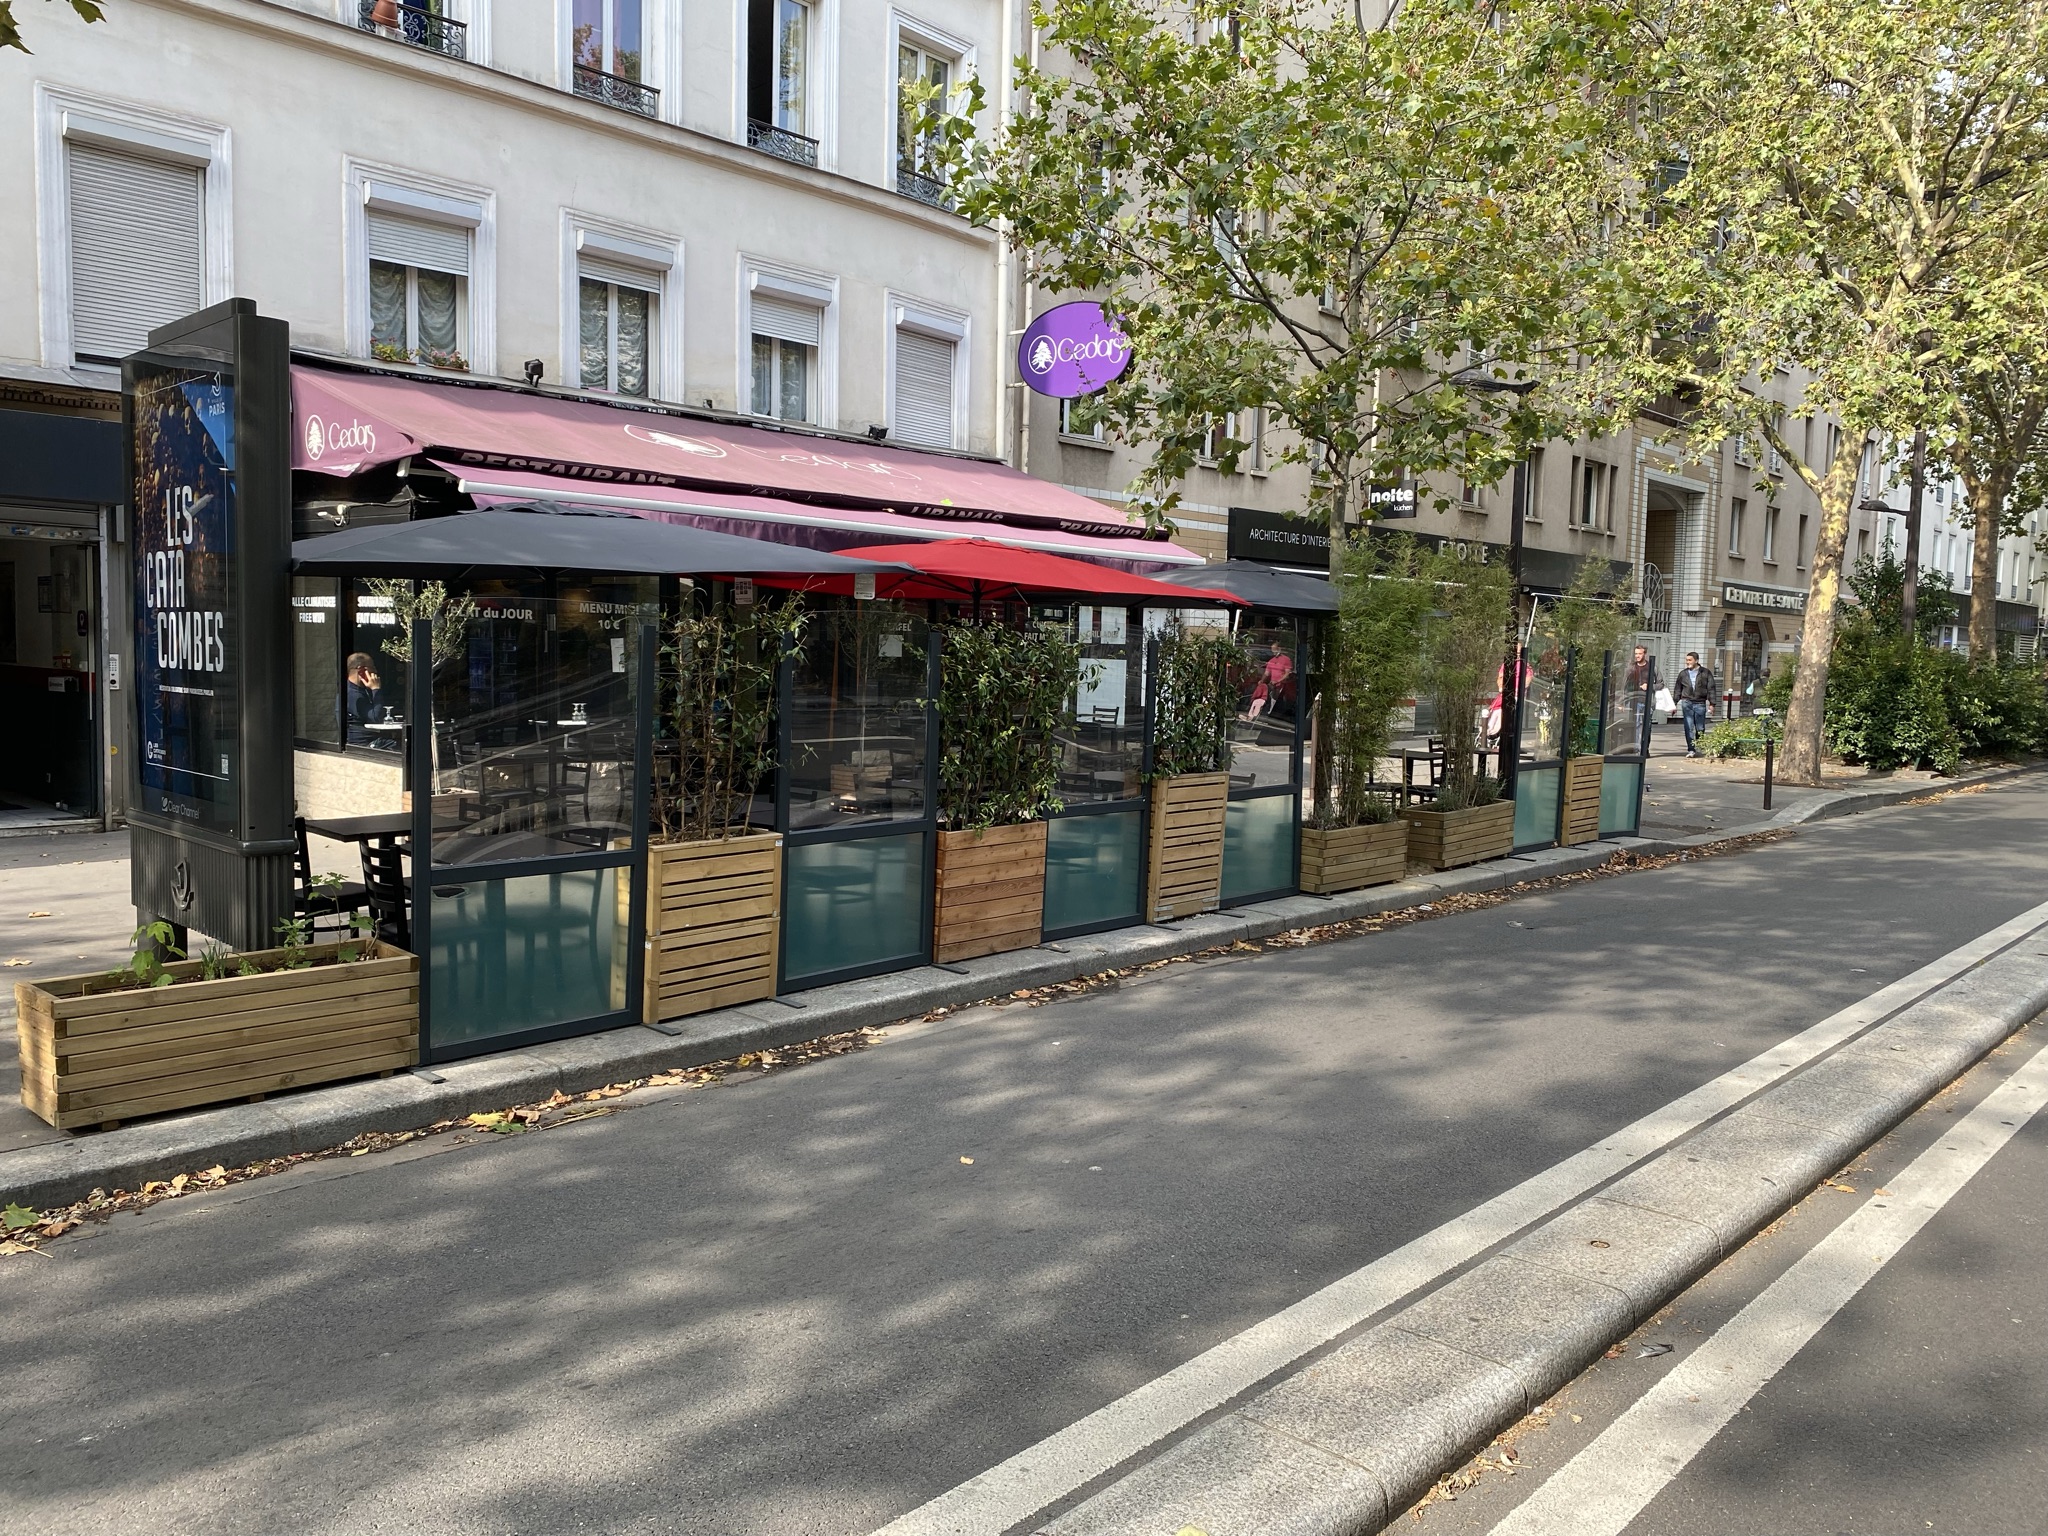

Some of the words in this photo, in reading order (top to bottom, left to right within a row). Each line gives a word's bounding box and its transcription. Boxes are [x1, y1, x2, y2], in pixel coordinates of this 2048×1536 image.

[1057, 333, 1124, 364] Cedars
[328, 418, 376, 454] Cedars
[165, 485, 193, 547] LES
[1249, 528, 1300, 545] ARCHITECTURE
[146, 549, 185, 608] CATA
[1725, 586, 1763, 606] CENTRE
[1763, 592, 1777, 607] DE
[483, 607, 499, 619] du
[501, 608, 533, 620] JOUR
[579, 602, 612, 614] MENU
[961, 618, 983, 627] PLAS
[157, 611, 224, 673] COMBES
[168, 800, 180, 814] Clear
[180, 804, 200, 819] Channel
